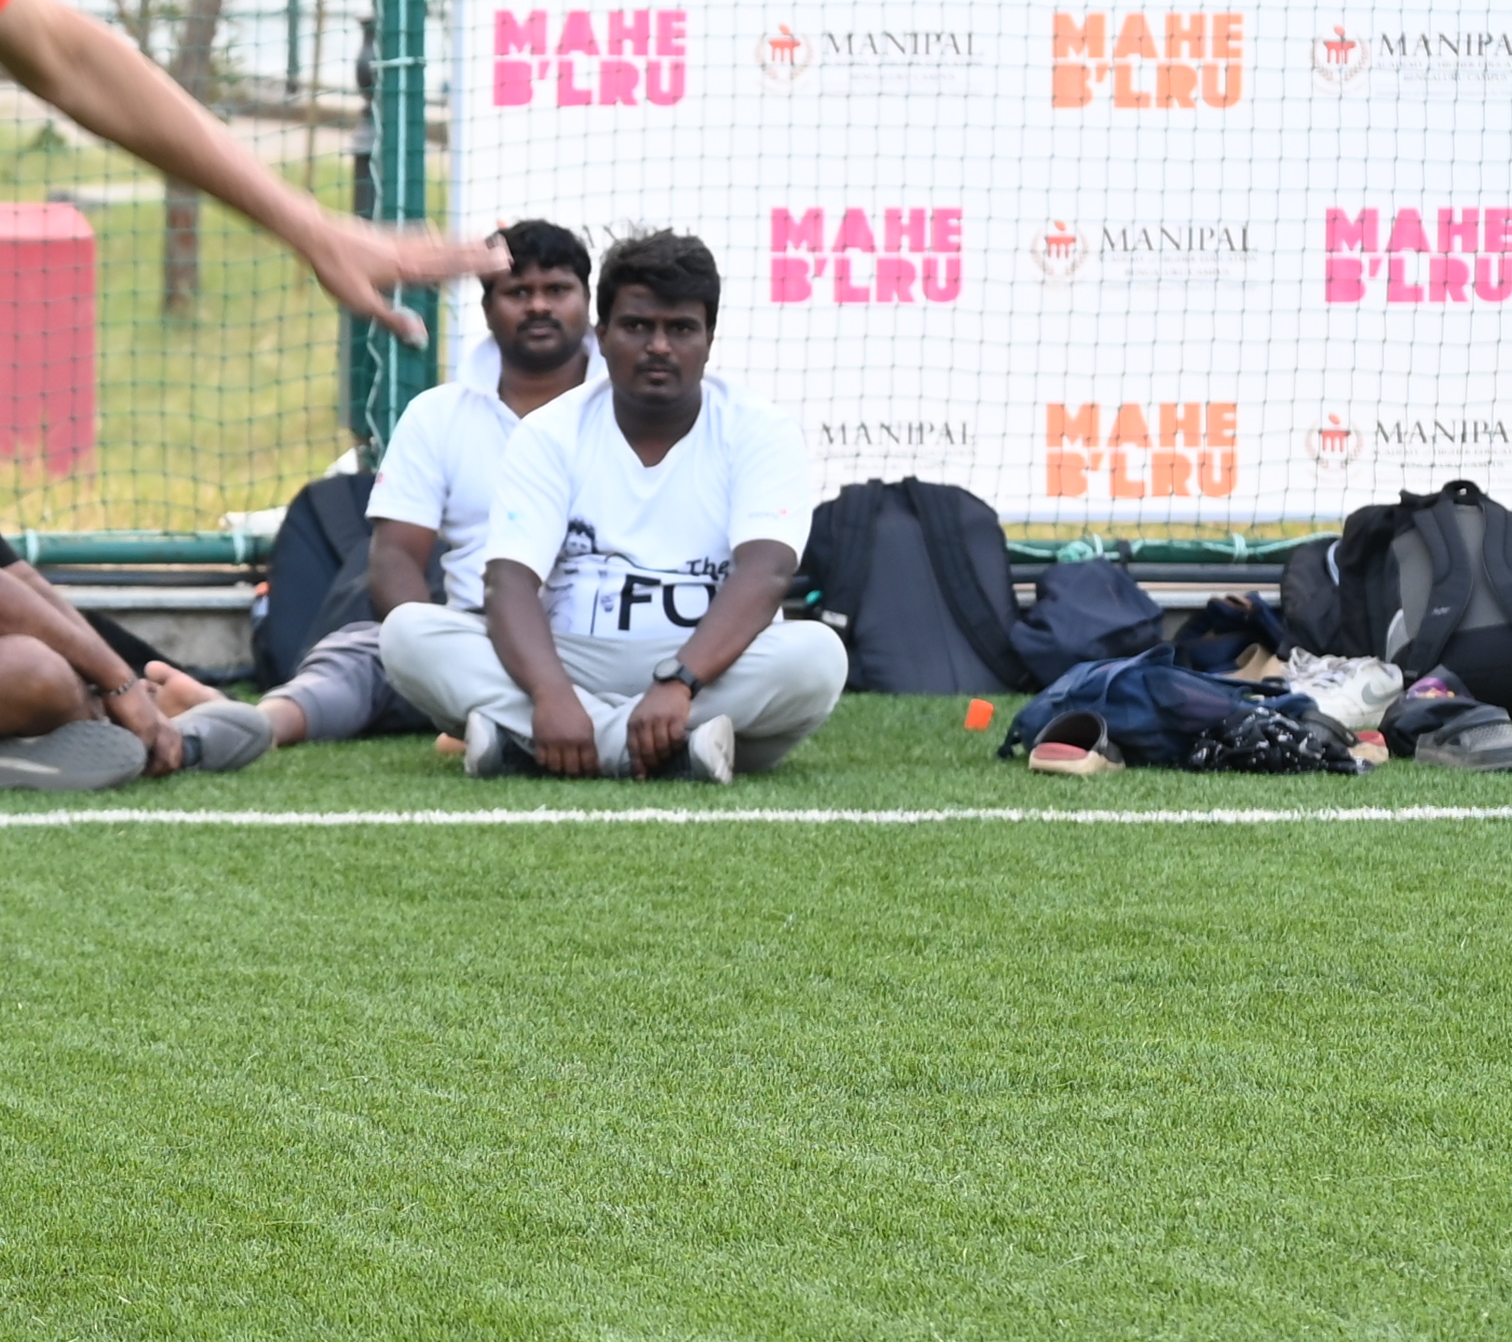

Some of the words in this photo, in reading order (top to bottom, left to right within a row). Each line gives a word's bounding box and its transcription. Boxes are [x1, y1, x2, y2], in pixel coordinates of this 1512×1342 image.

[496, 11, 687, 57] MAHE
[823, 31, 983, 57] MANIPAL
[1055, 15, 1243, 59] MAHE
[495, 61, 686, 107] B'LRU
[1054, 65, 1242, 109] B'LRU
[773, 209, 963, 254] MAHE
[1099, 225, 1258, 252] MANIPAL
[772, 258, 962, 304] B'LRU
[819, 420, 976, 446] MANIPAL
[1048, 404, 1237, 449] MAHE
[1048, 452, 1237, 499] B'LRU
